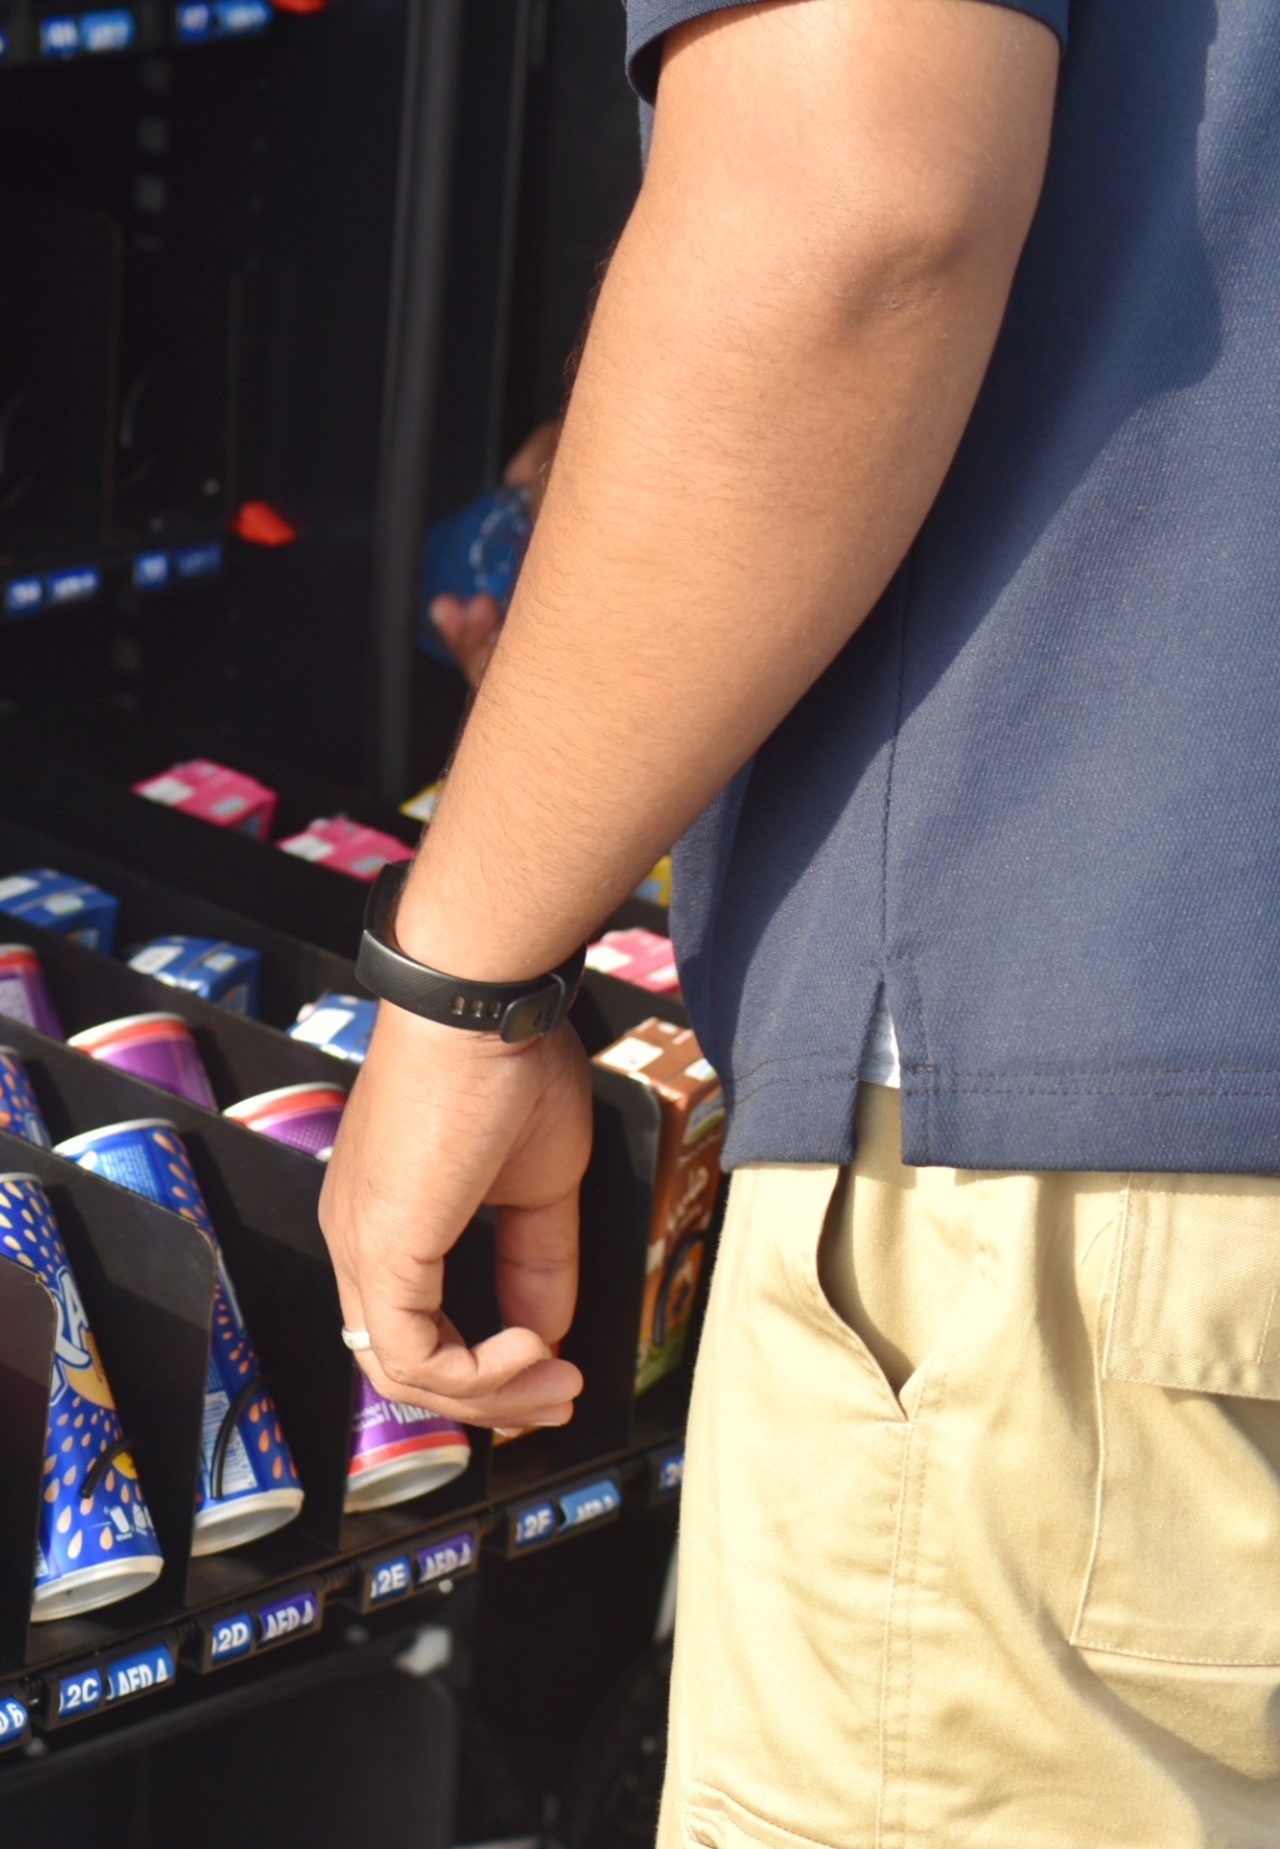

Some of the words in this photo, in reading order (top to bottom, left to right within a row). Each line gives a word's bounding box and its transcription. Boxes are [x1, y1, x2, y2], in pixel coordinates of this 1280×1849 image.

[525, 1508, 552, 1538] 2F
[377, 1563, 407, 1593] 2E
[219, 1622, 249, 1650] 2D
[66, 1678, 98, 1709] 2C
